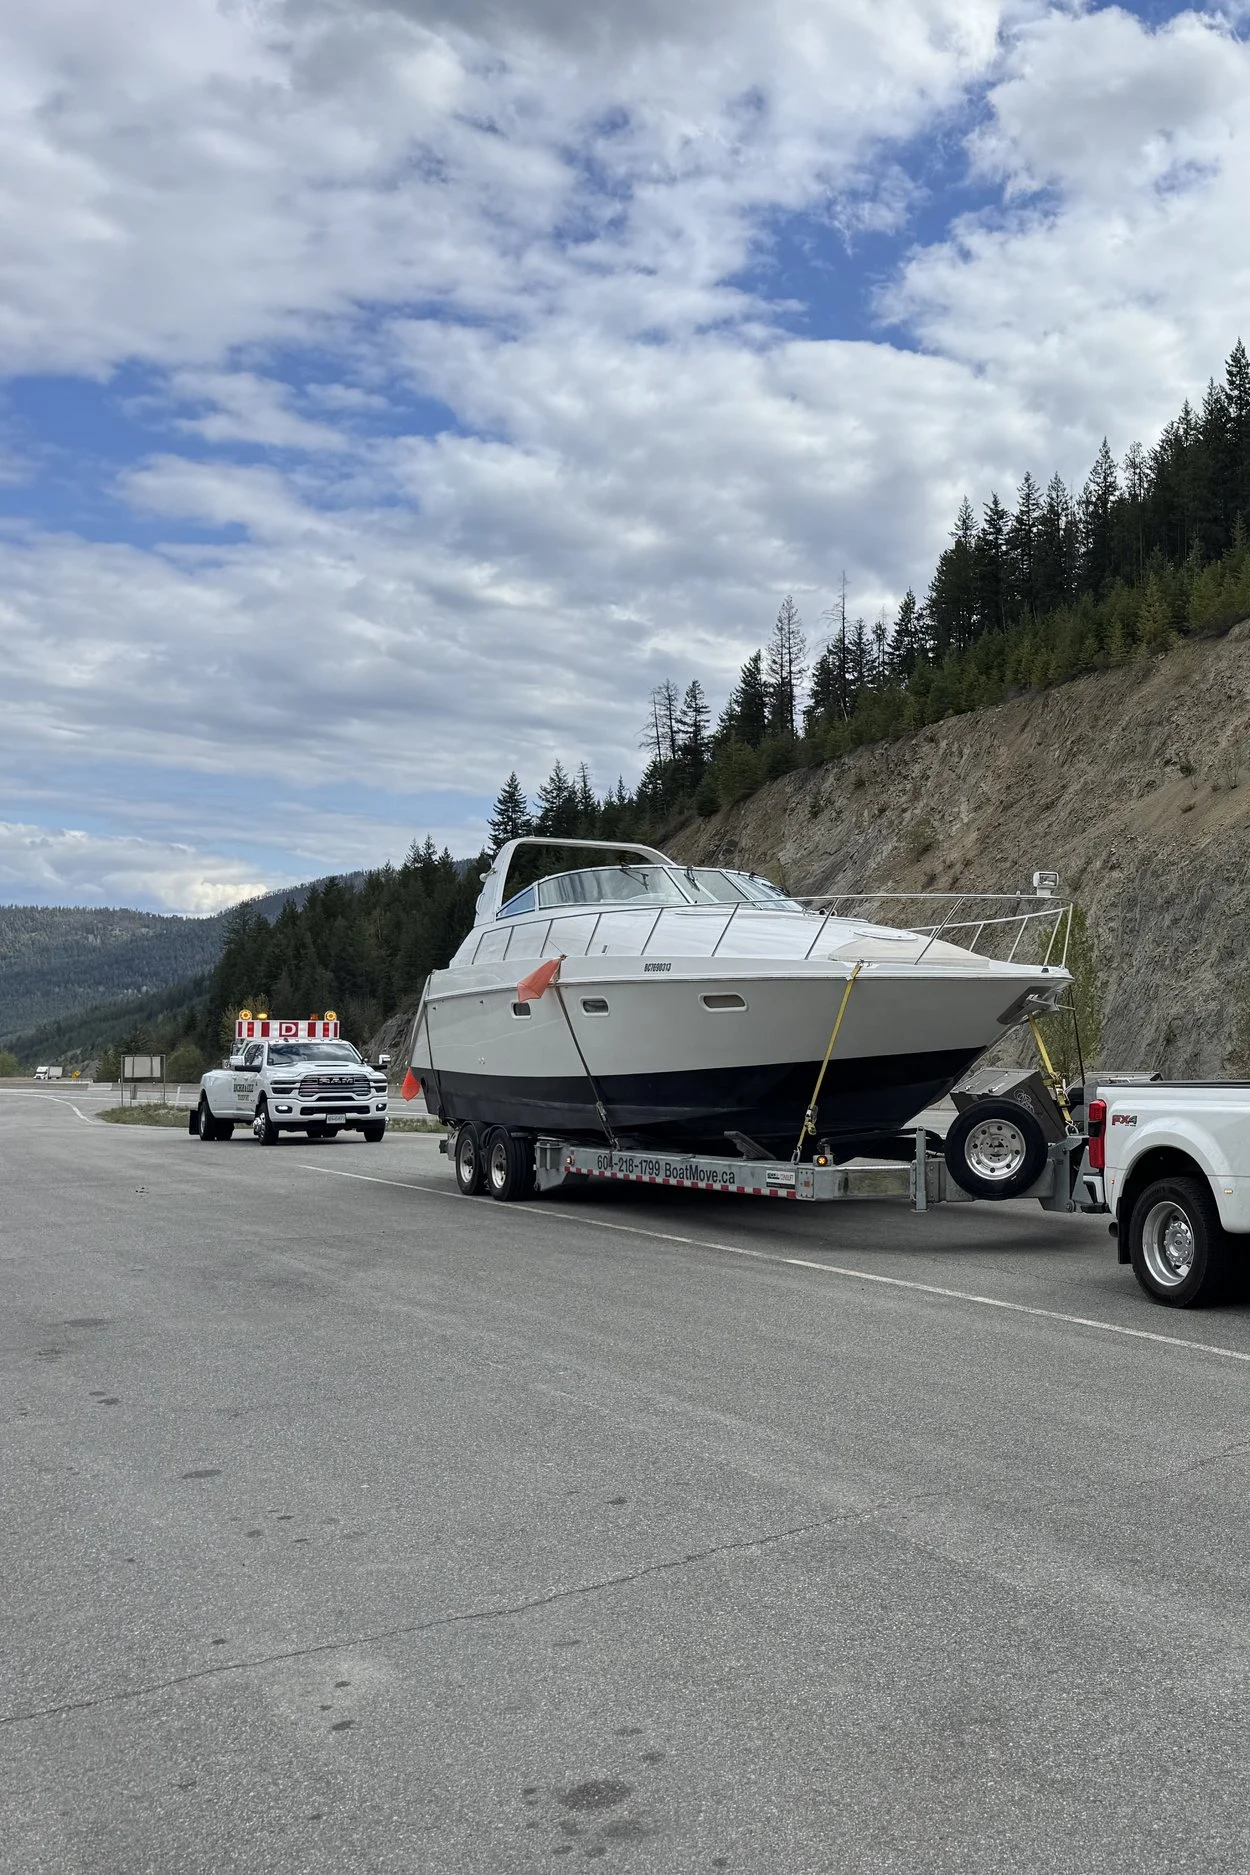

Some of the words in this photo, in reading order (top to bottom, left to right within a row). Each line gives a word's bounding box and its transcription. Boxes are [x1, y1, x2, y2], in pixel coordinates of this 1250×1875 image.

[281, 1023, 296, 1035] D
[1111, 1114, 1138, 1126] FX4
[597, 1154, 661, 1177] 604-218-1799
[664, 1162, 736, 1184] BoatMove.ca
